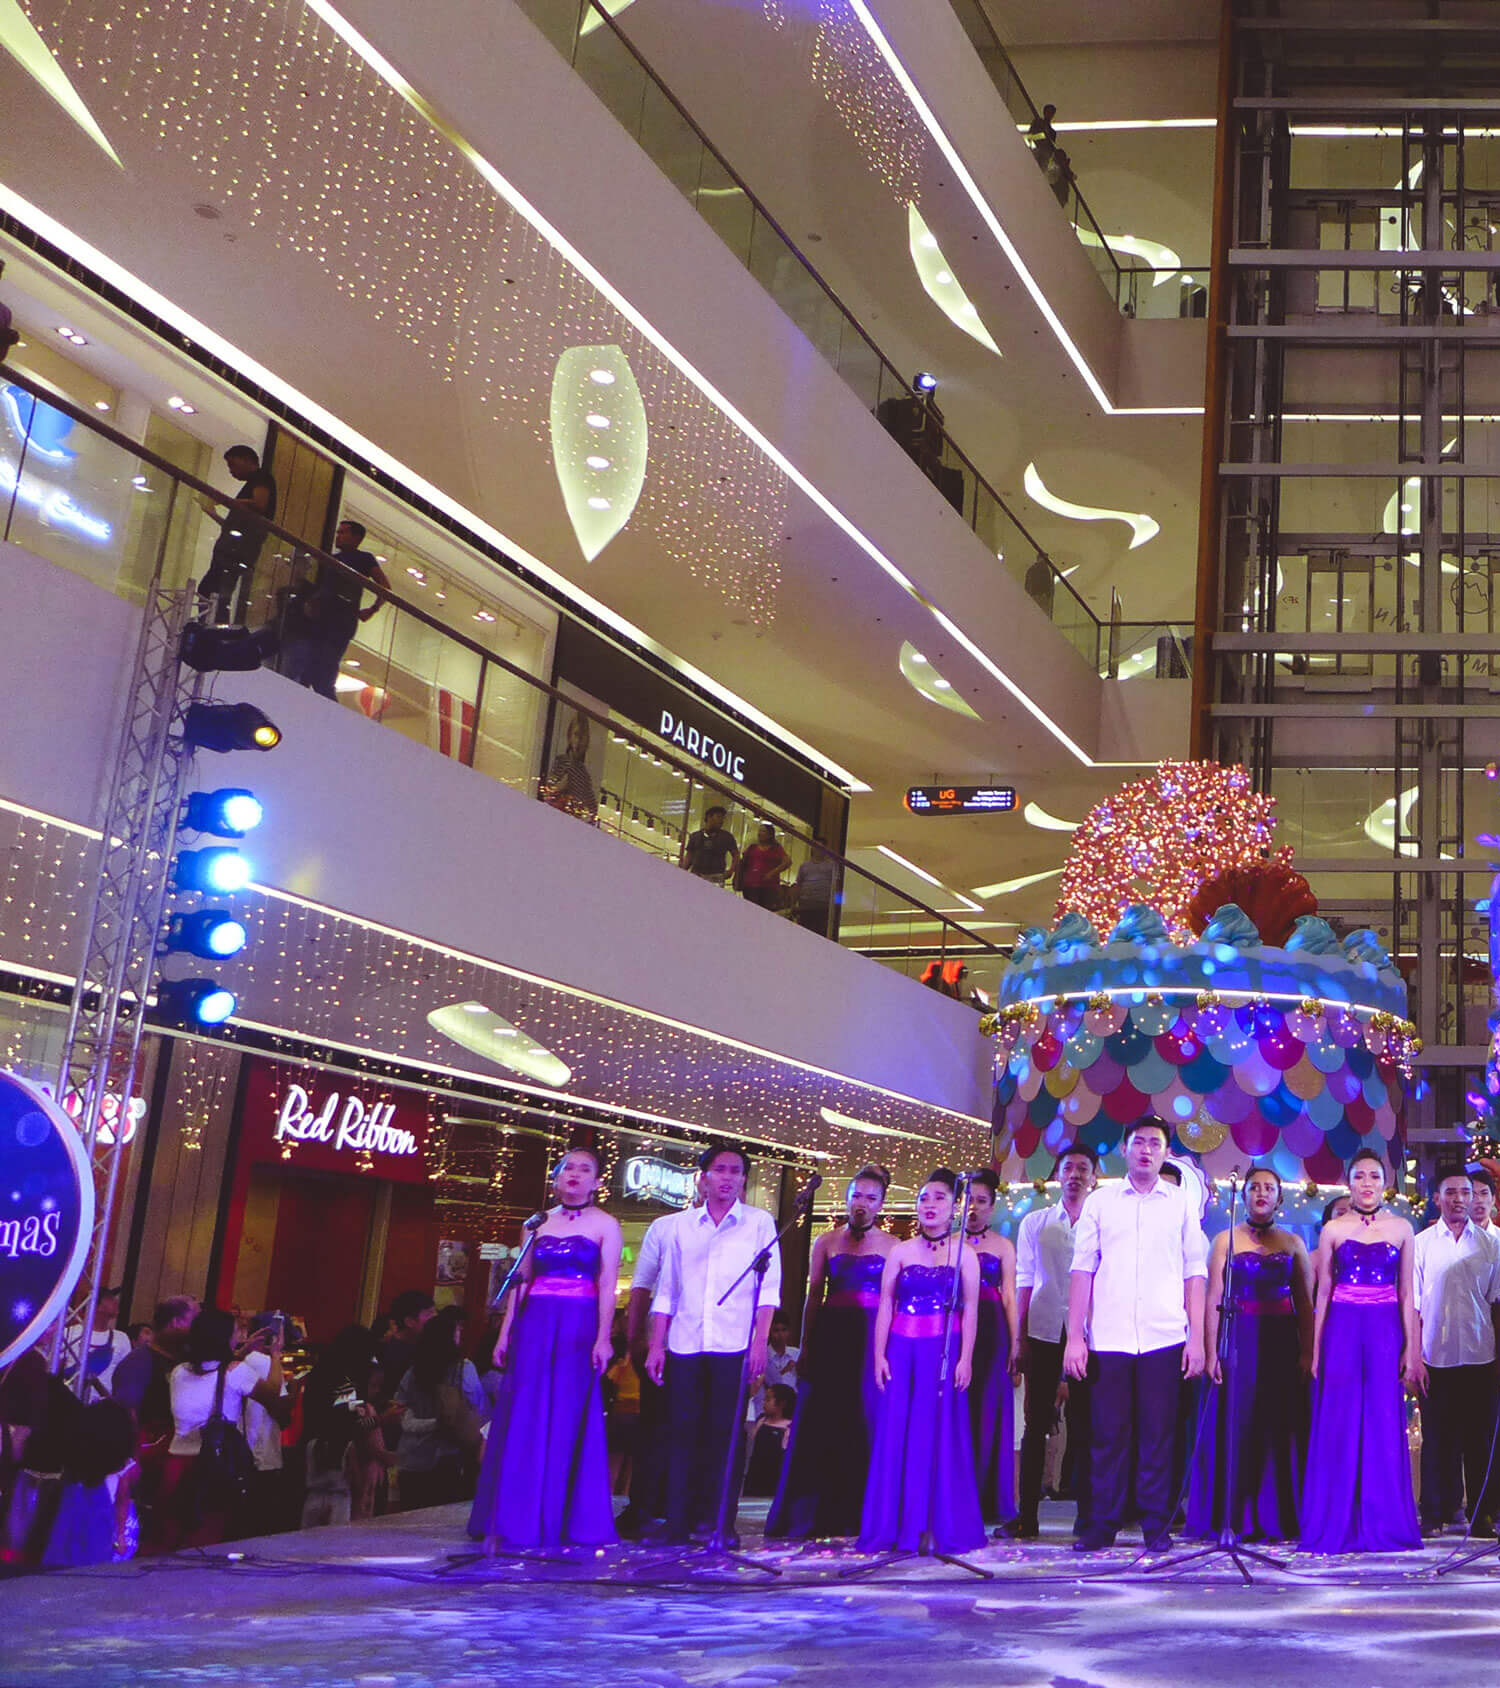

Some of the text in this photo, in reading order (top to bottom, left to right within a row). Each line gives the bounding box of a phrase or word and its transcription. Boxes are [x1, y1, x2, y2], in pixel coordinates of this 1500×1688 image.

[660, 709, 746, 782] PARFOIS
[277, 1083, 419, 1155] Red Ribbon
